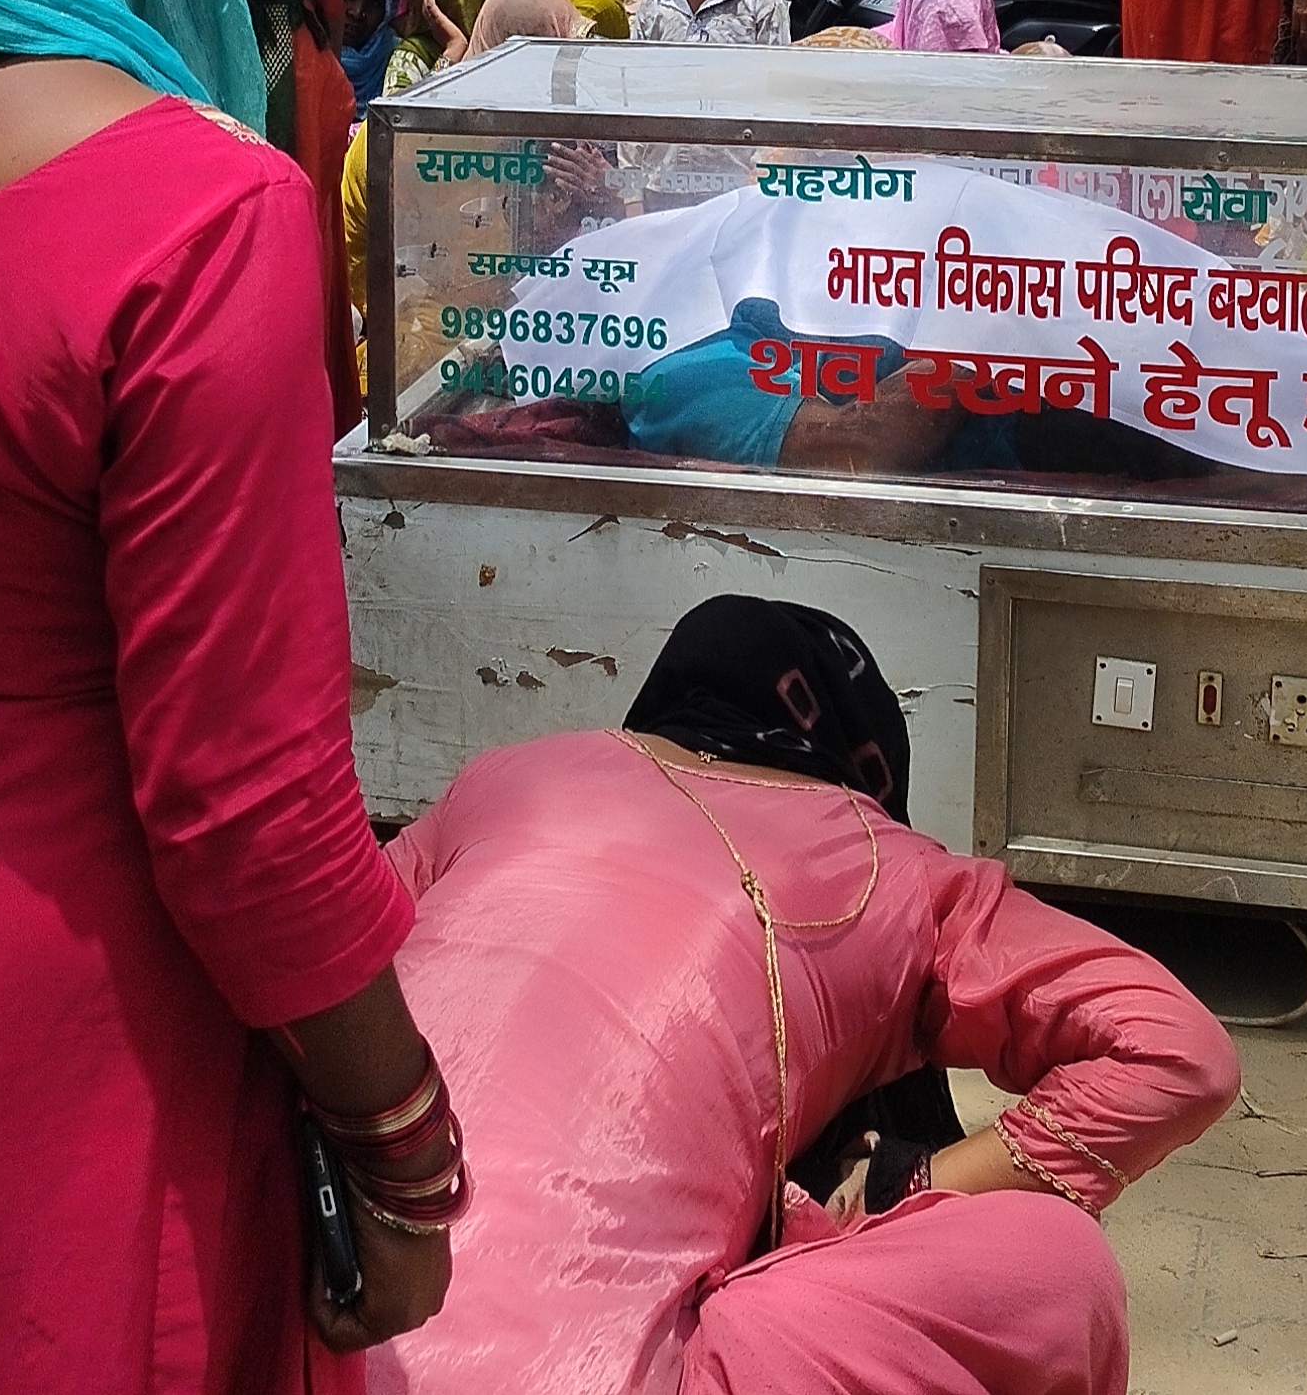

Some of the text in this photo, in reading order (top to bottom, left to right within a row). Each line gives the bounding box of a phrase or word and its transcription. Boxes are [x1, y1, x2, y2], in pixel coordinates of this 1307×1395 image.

[416, 142, 546, 187] सम्पर्क
[757, 154, 917, 202] सहयोग
[1182, 175, 1274, 224] सेवा
[469, 249, 638, 293] सम्पर्क सूत्र
[827, 246, 924, 309] भारत
[935, 225, 1064, 319] विकास
[1075, 236, 1197, 327] परिषद
[440, 306, 668, 351] 9896837696
[440, 360, 667, 406] 9416042954
[748, 338, 884, 403] शव
[903, 336, 1120, 415] रखने
[1141, 340, 1292, 448] हेतू
